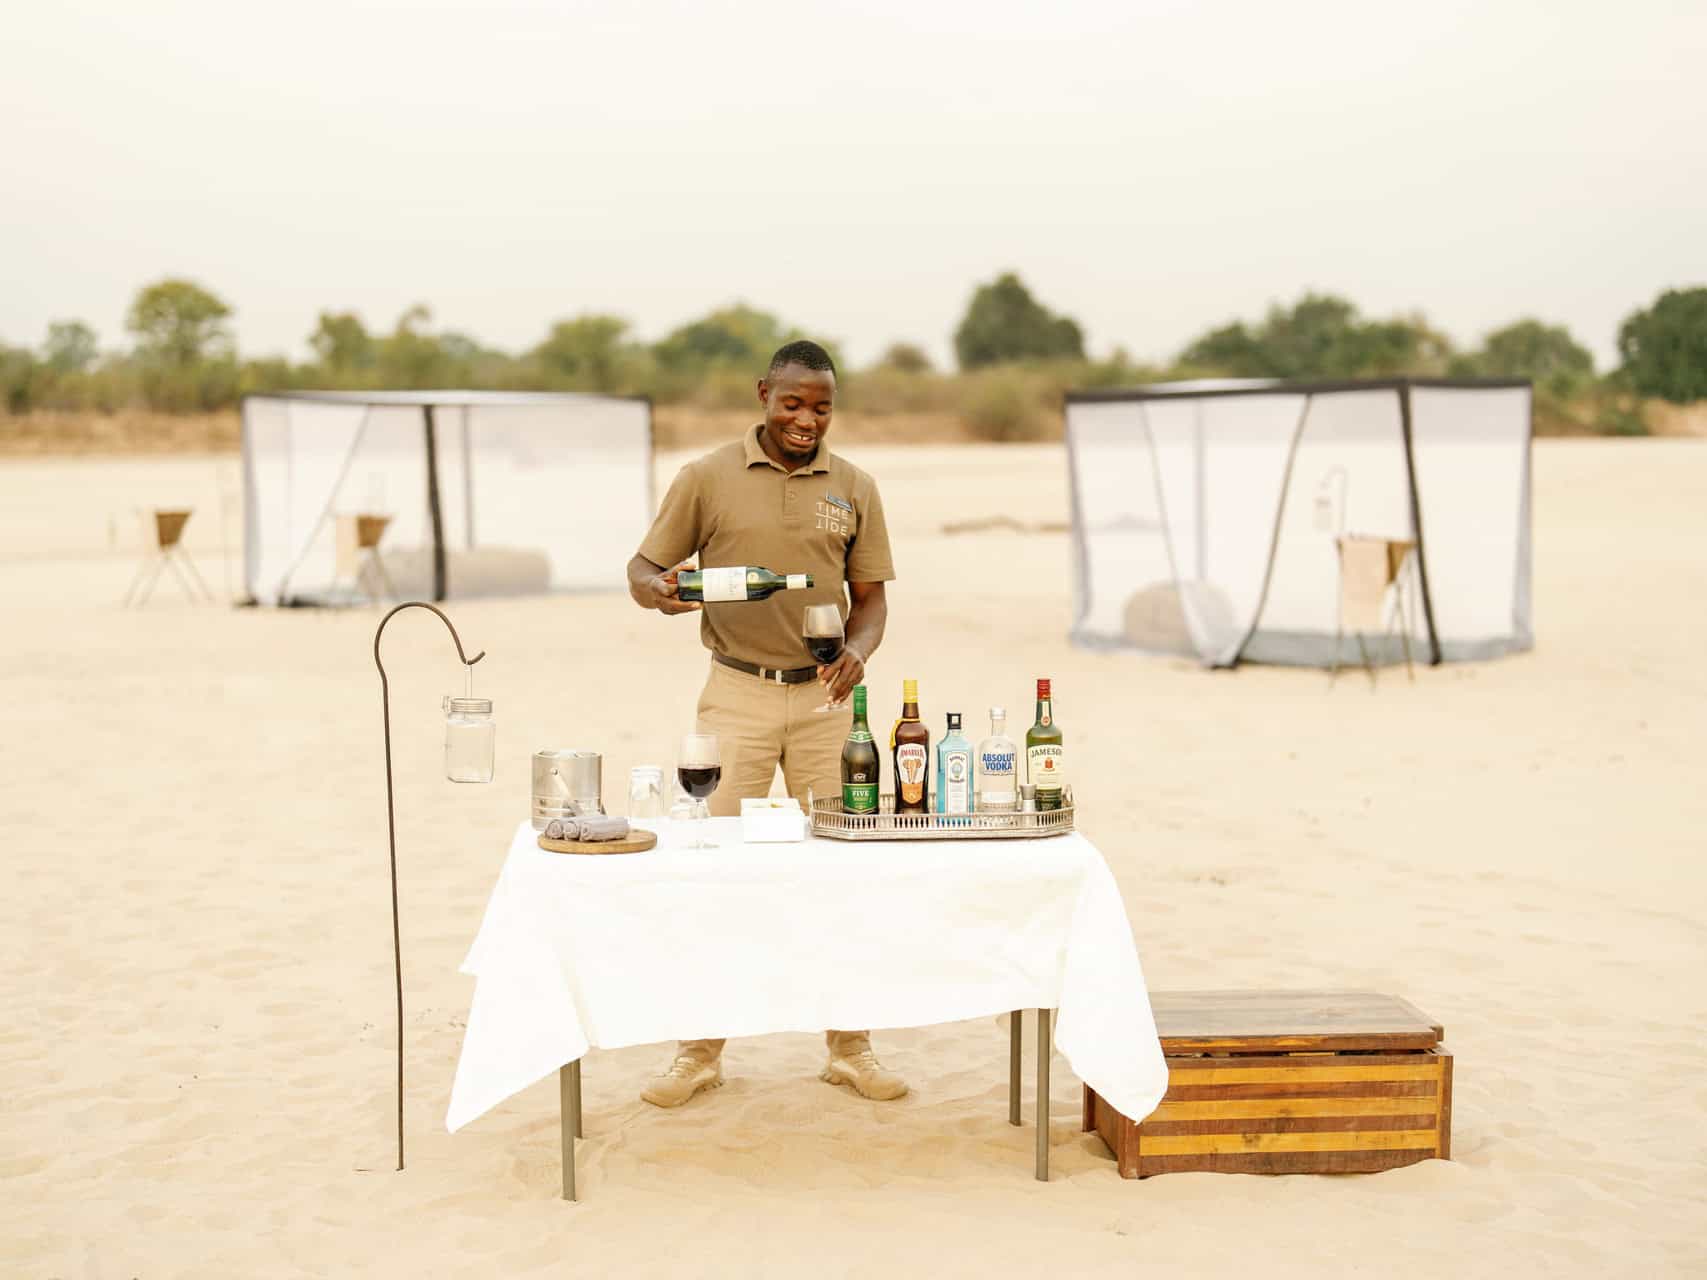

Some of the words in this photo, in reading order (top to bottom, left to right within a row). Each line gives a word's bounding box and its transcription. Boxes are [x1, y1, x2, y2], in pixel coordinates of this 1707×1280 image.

[816, 502, 848, 520] TIME
[816, 518, 848, 536] TIDE
[982, 752, 1015, 762] ABSOLUT
[1031, 748, 1062, 758] JAMESO
[985, 761, 1013, 770] VODKA
